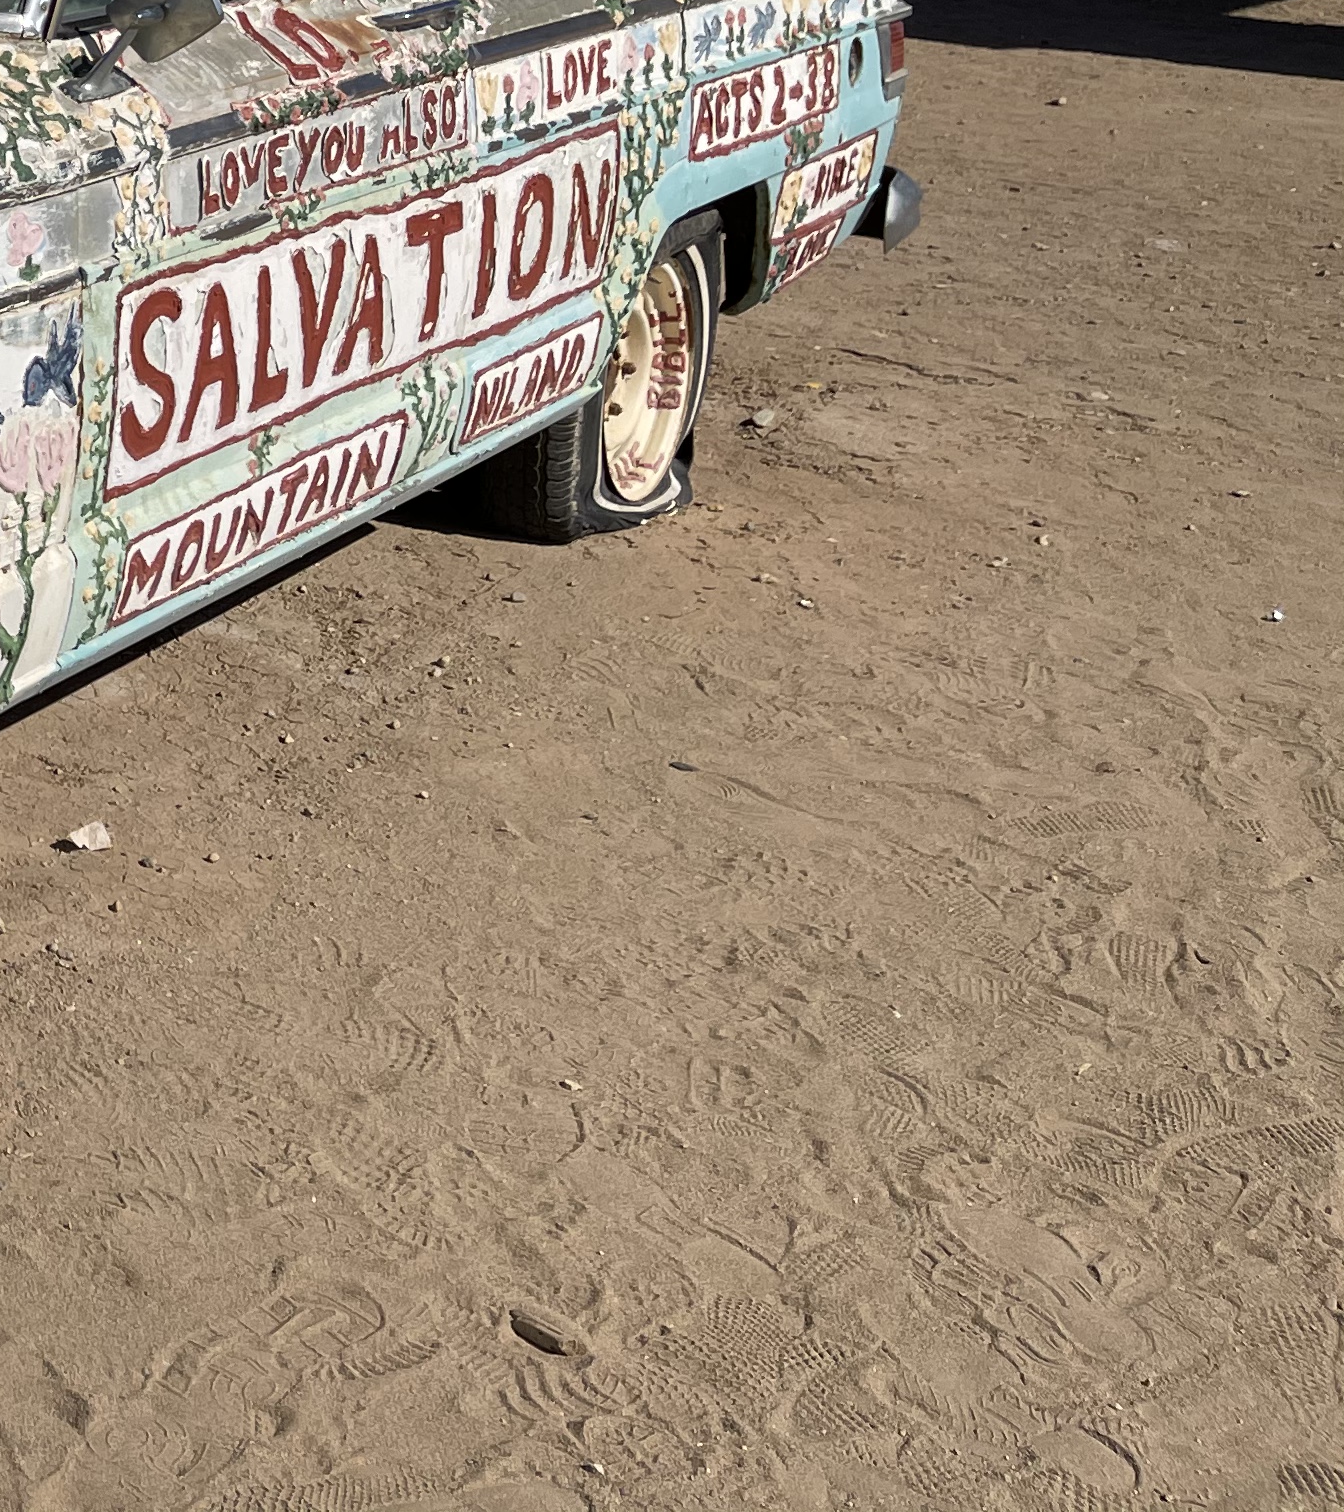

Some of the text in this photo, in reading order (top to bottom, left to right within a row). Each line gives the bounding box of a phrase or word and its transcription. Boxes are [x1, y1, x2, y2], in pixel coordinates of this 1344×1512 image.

[201, 134, 288, 216] LOVE
[290, 121, 366, 196] YOU
[698, 70, 764, 154] ACTS
[120, 159, 613, 461] SALVATION
[116, 430, 389, 615] MOUNTAIN
